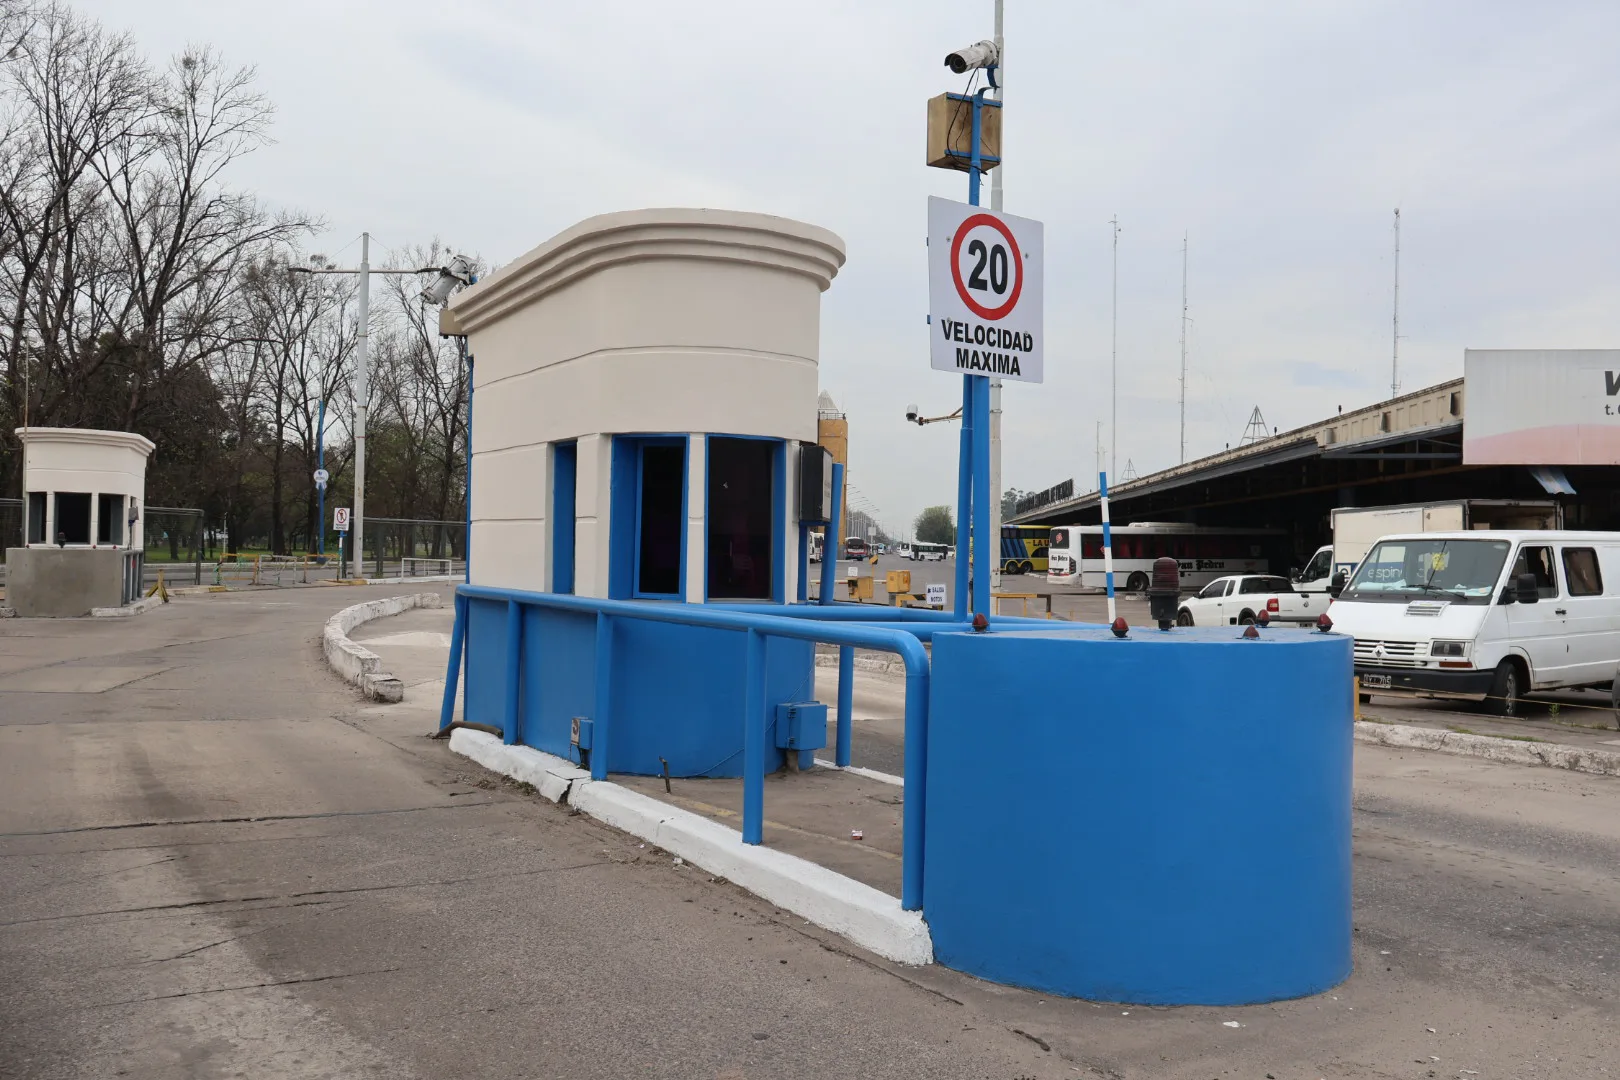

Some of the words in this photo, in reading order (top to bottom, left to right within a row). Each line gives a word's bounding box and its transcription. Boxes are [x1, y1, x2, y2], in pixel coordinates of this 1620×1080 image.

[968, 239, 1008, 295] 20
[941, 319, 1033, 353] VELOCIDAD
[956, 347, 1021, 376] MAXIMA
[1368, 566, 1402, 580] espin
